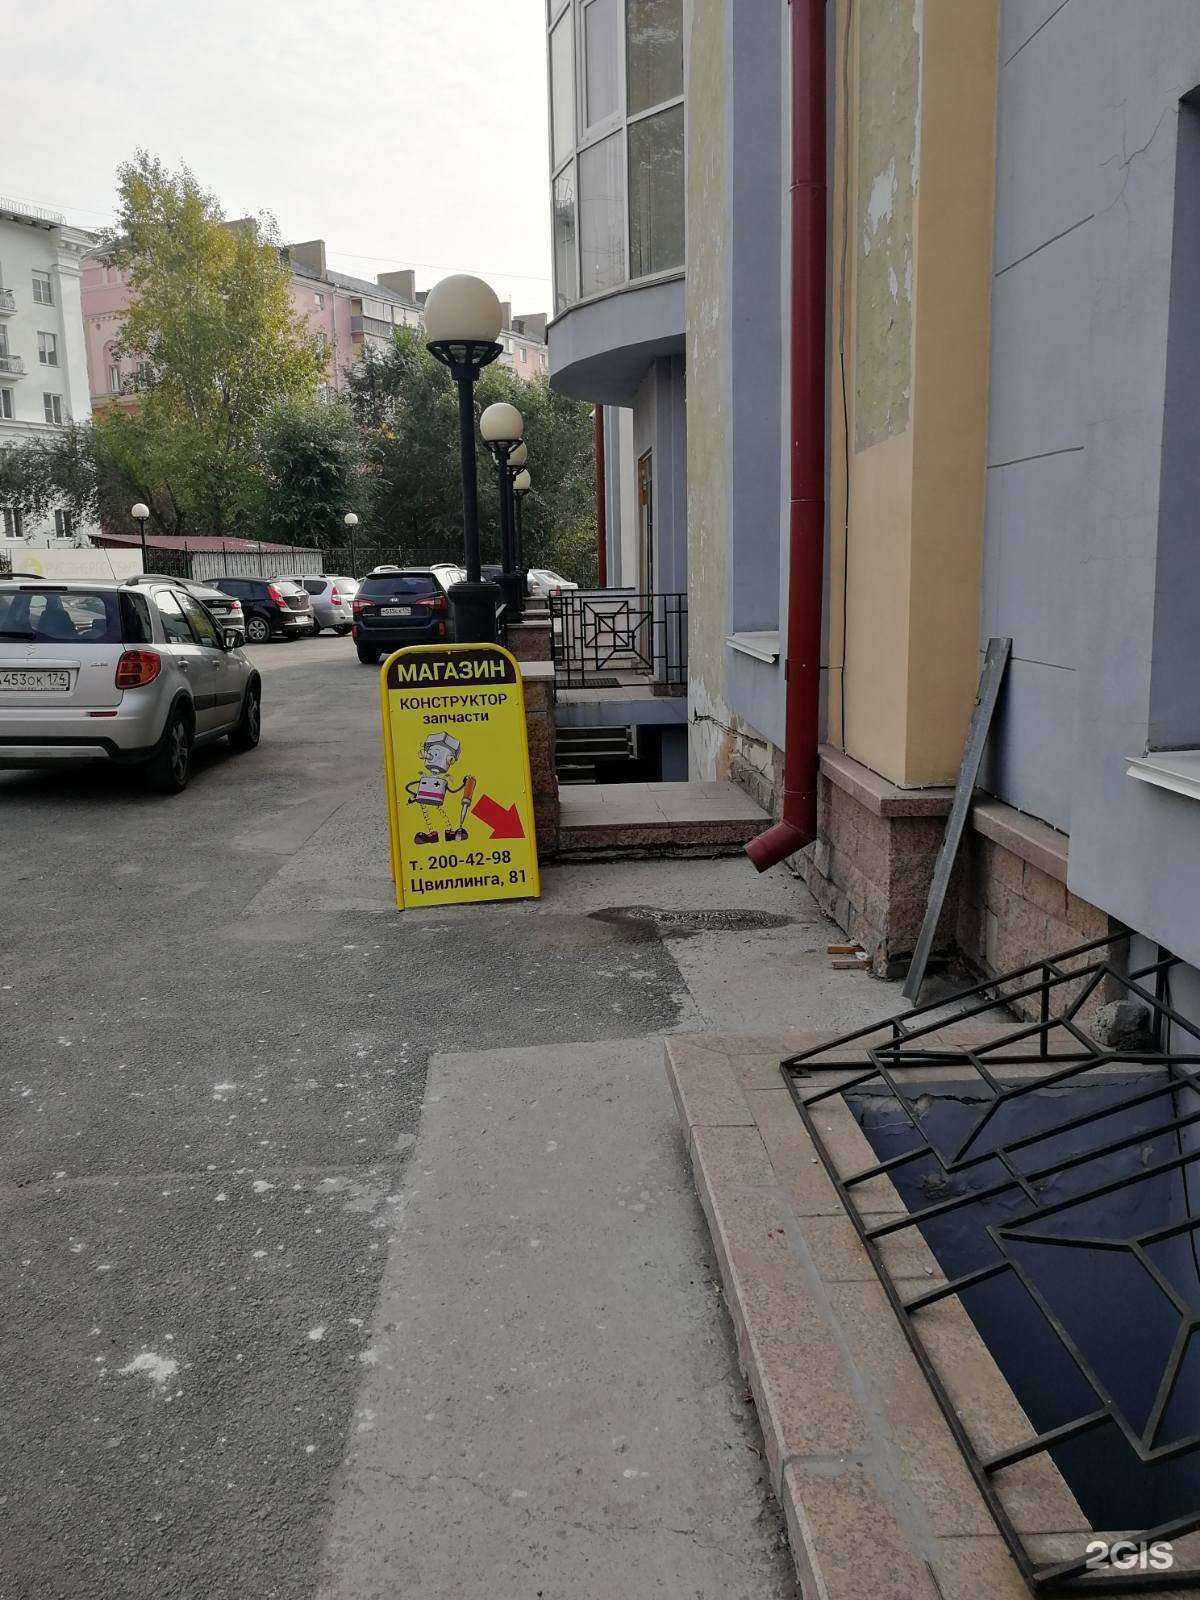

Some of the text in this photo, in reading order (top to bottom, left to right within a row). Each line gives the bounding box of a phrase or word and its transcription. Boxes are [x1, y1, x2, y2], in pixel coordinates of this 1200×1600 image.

[47, 673, 66, 686] 174
[397, 659, 506, 683] МАГАЗИН
[400, 693, 507, 710] КОНСТРУКТОР
[423, 712, 489, 725] запчасти
[409, 850, 511, 871] т. 200-42-98
[410, 870, 526, 894] Цвиллинга, 81
